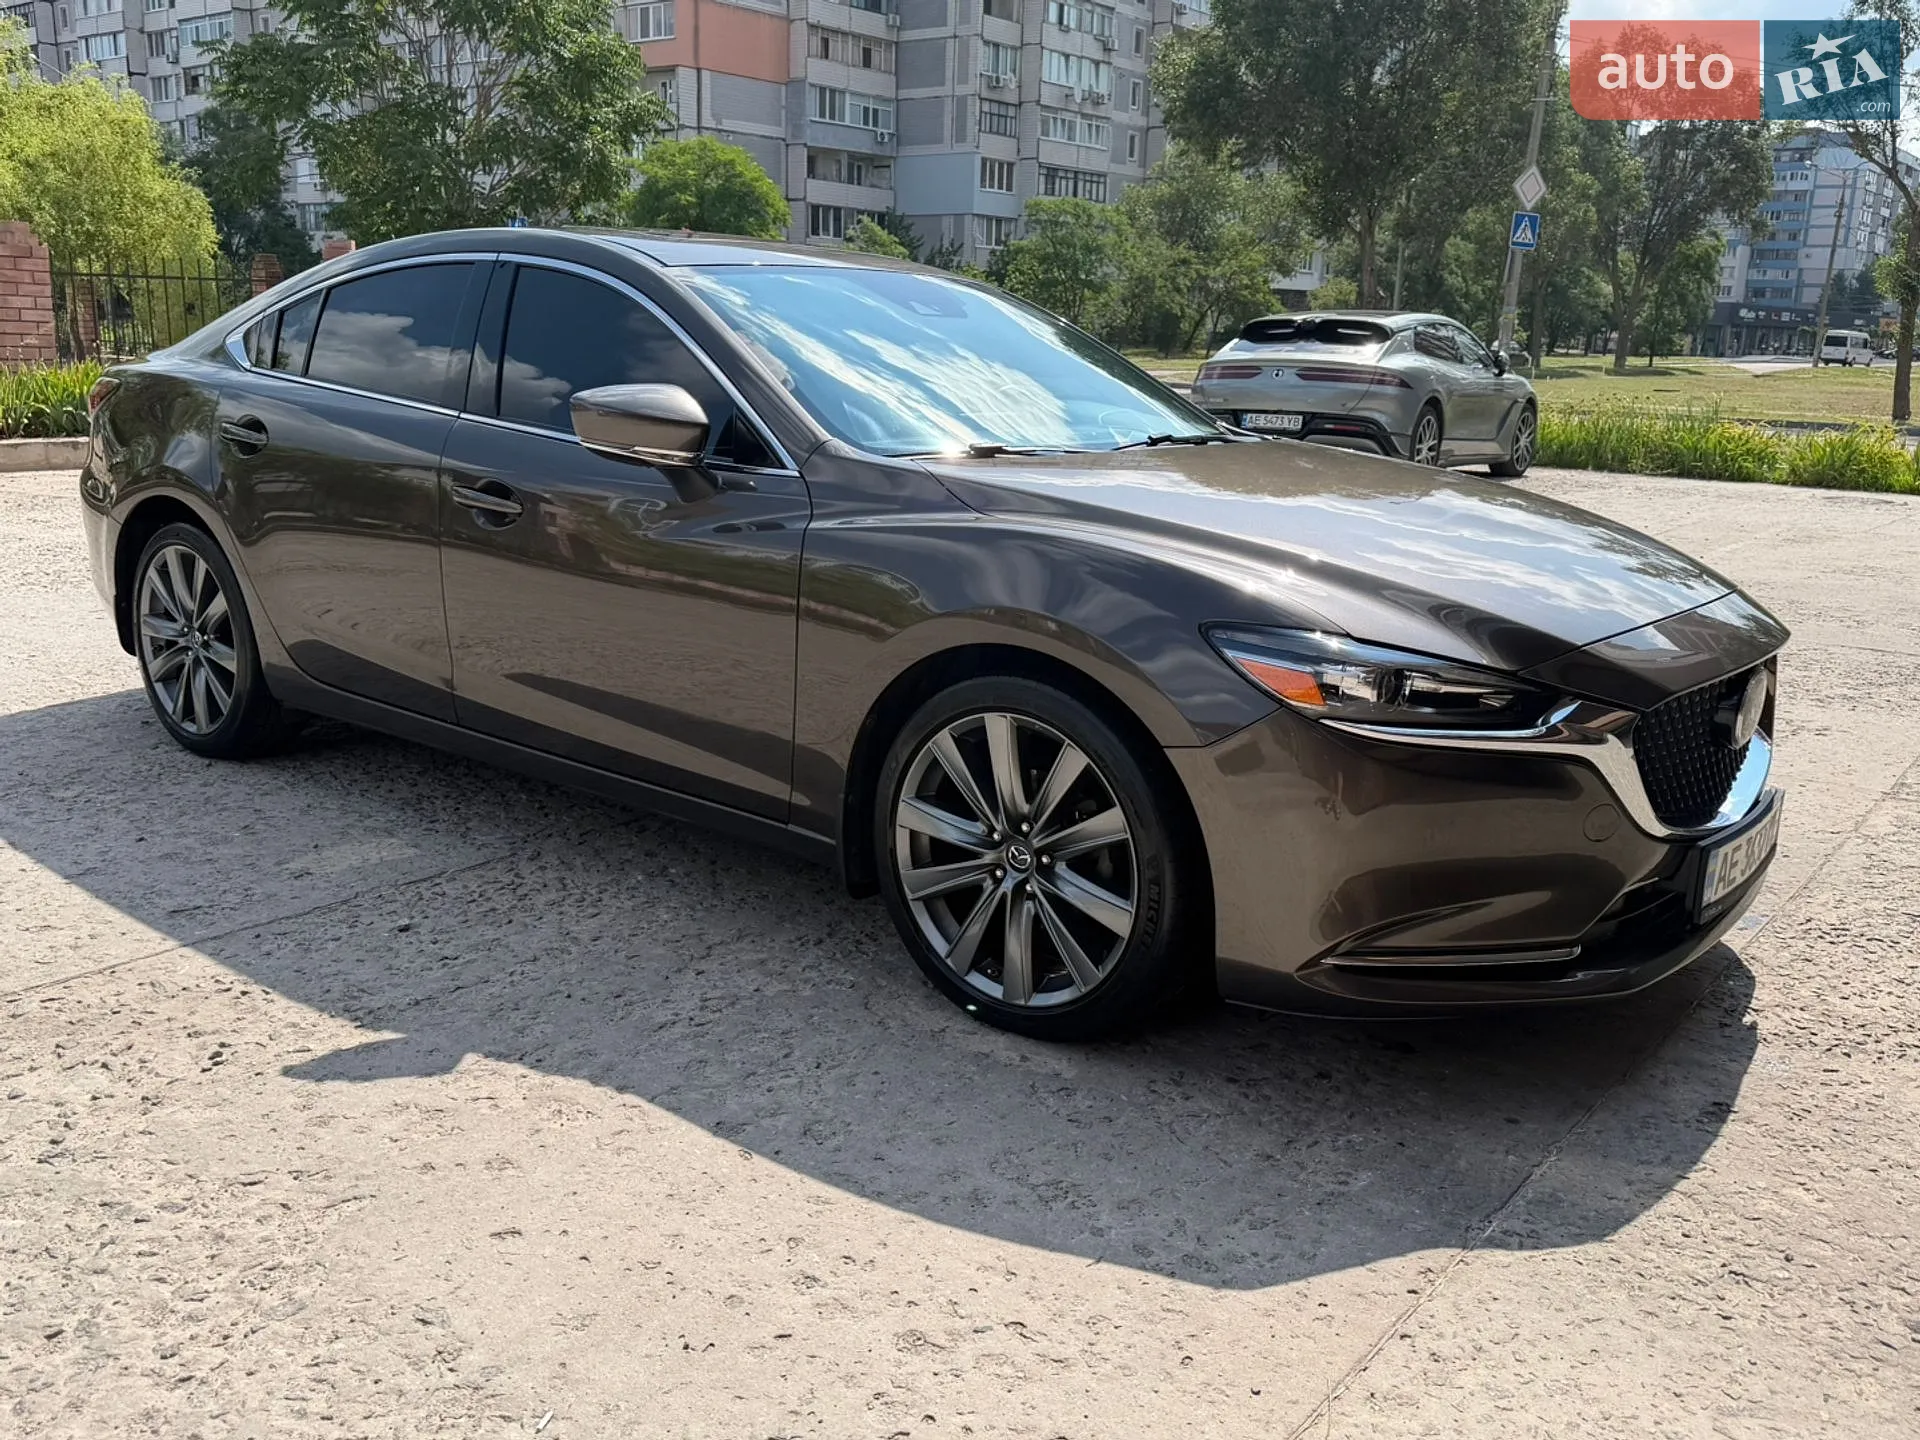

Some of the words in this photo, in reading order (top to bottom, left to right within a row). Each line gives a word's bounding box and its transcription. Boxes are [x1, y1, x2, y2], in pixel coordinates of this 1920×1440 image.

[1248, 415, 1260, 425] AE
[1262, 416, 1285, 426] 5473
[1287, 417, 1300, 427] YB
[1714, 844, 1742, 896] AE
